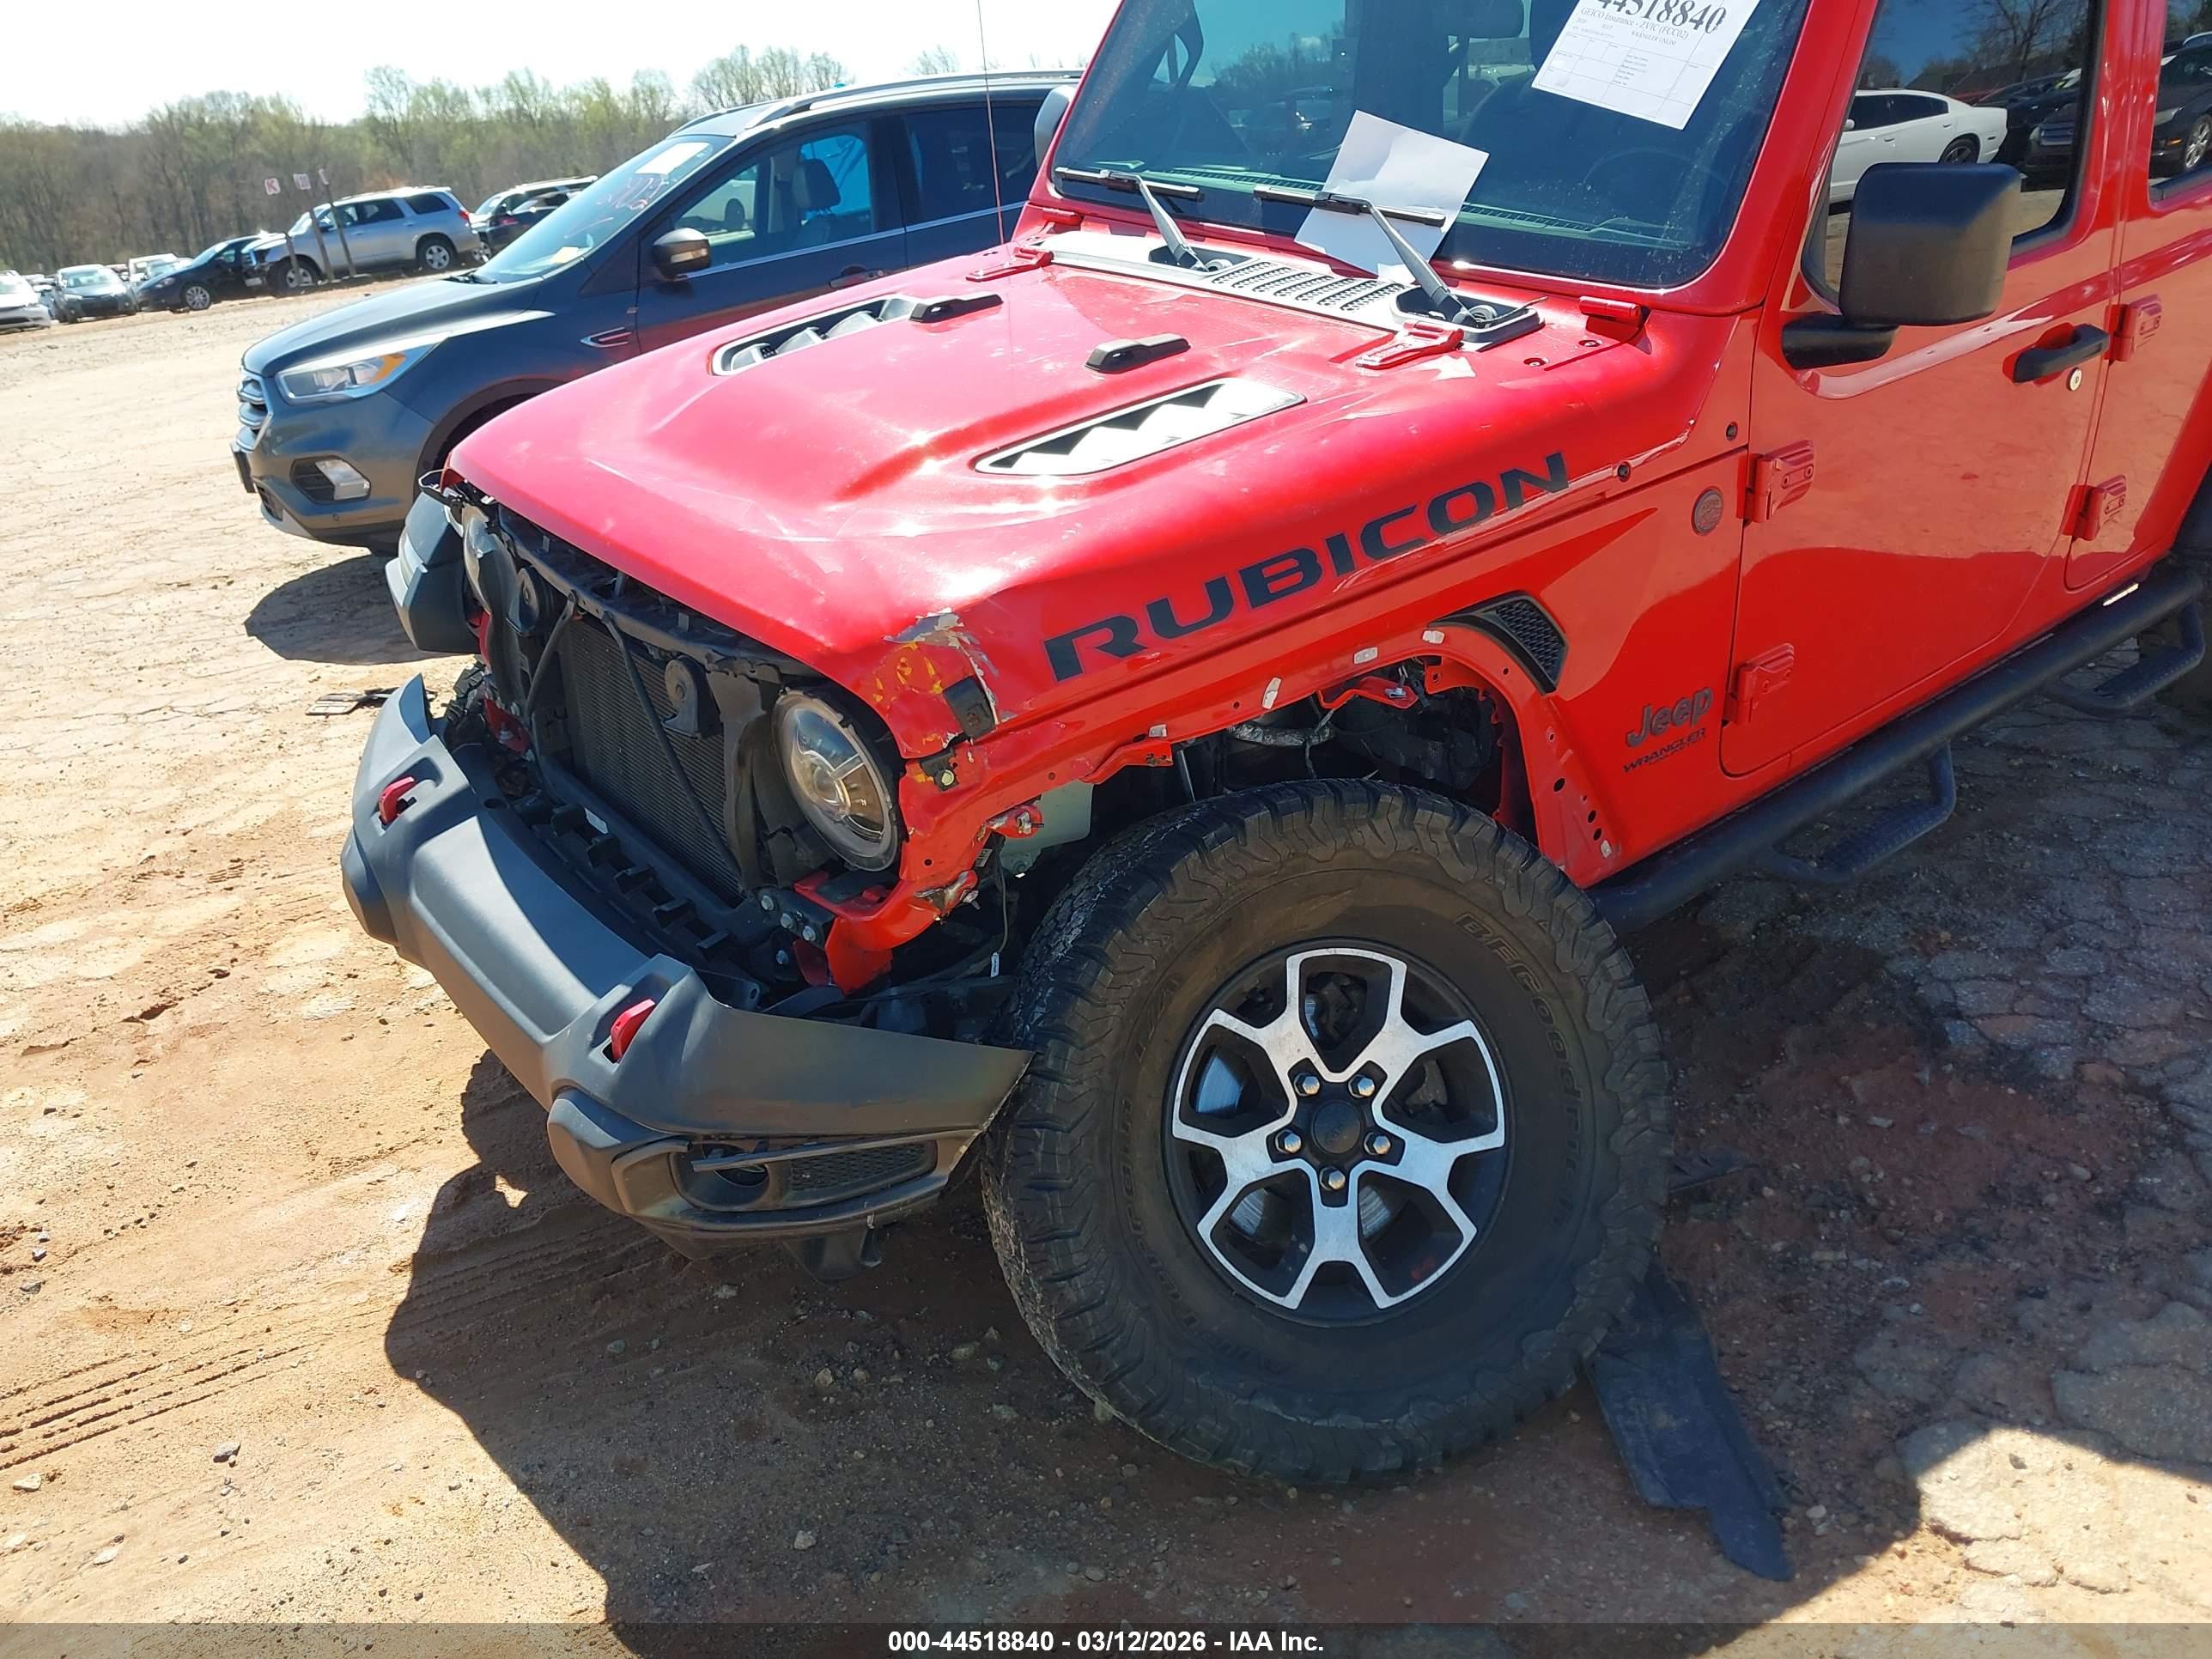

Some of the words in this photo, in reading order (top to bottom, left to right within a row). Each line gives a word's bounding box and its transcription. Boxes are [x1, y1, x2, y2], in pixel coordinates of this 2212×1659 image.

[1581, 7, 1605, 21] GEICO
[1604, 13, 1634, 27] Insurance
[1044, 452, 1571, 682] RUBICON
[1626, 687, 1713, 748] Jeep
[1623, 727, 1706, 773] WRANGLER
